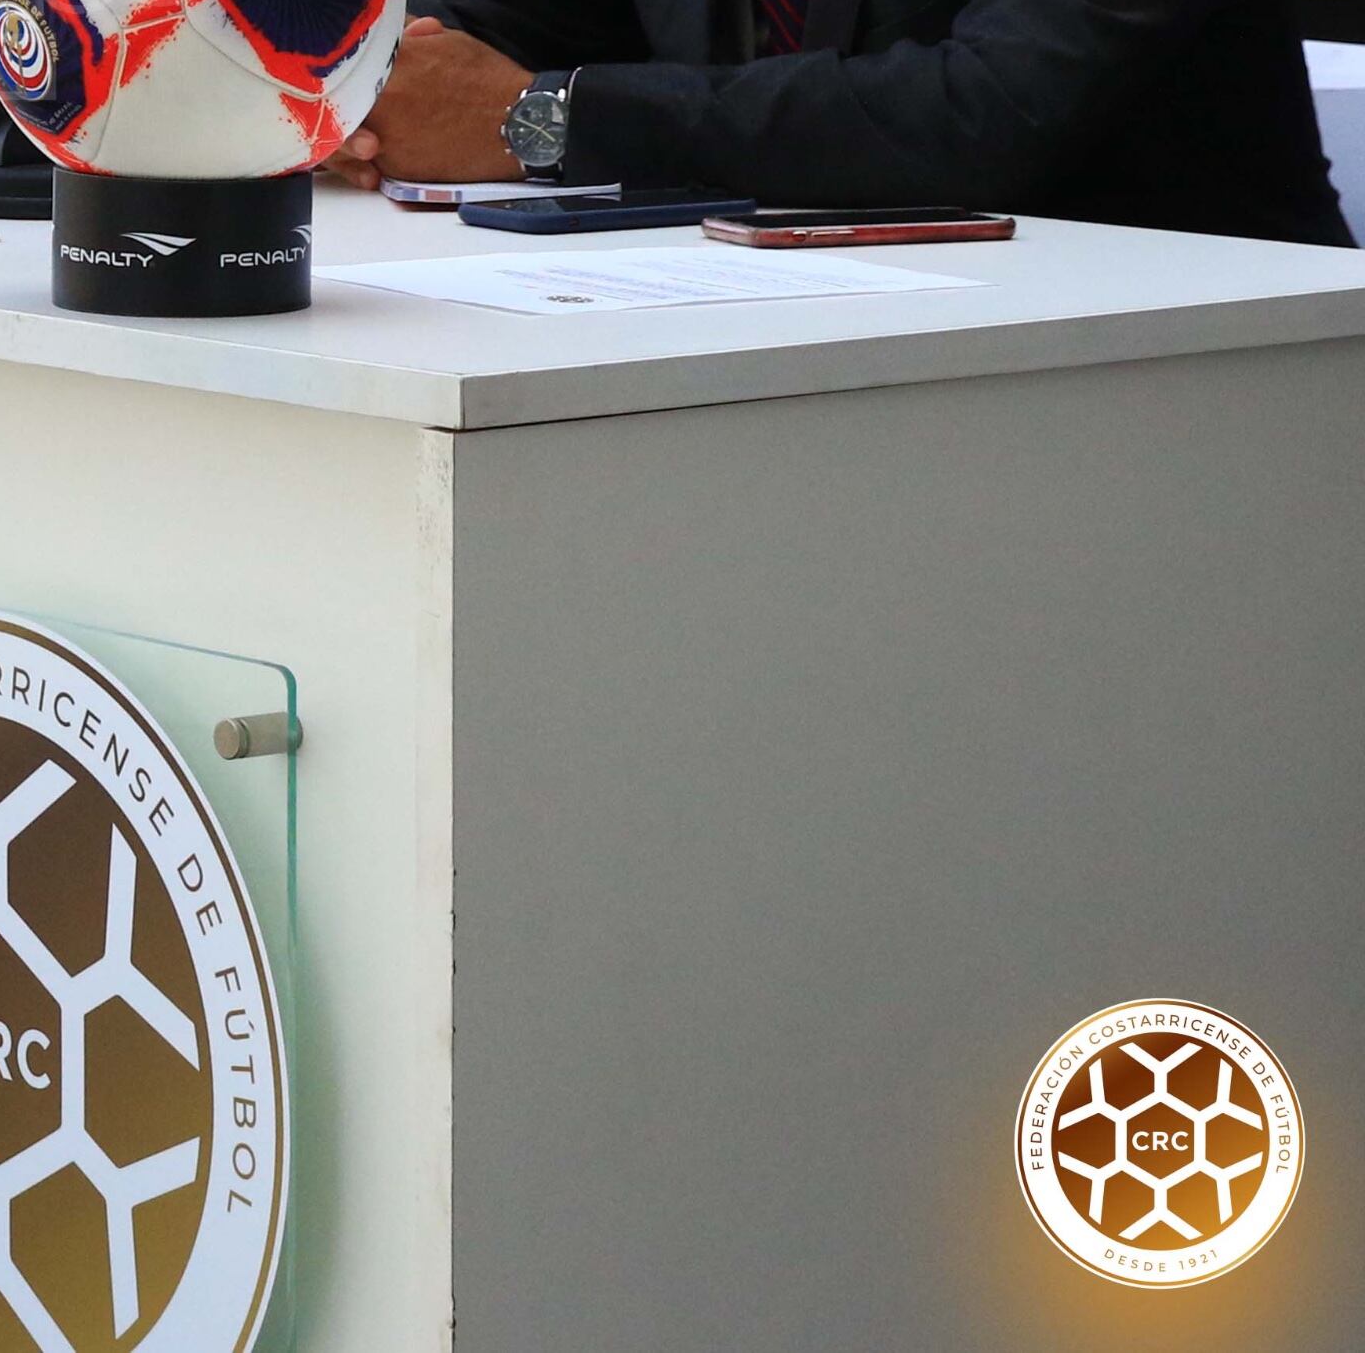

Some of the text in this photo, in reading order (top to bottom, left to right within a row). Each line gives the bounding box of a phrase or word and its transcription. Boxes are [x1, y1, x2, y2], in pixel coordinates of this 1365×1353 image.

[60, 244, 153, 268] PENALTY
[220, 246, 307, 268] PENALTY
[176, 852, 225, 937] DE
[213, 964, 257, 1215] FÚTBOL
